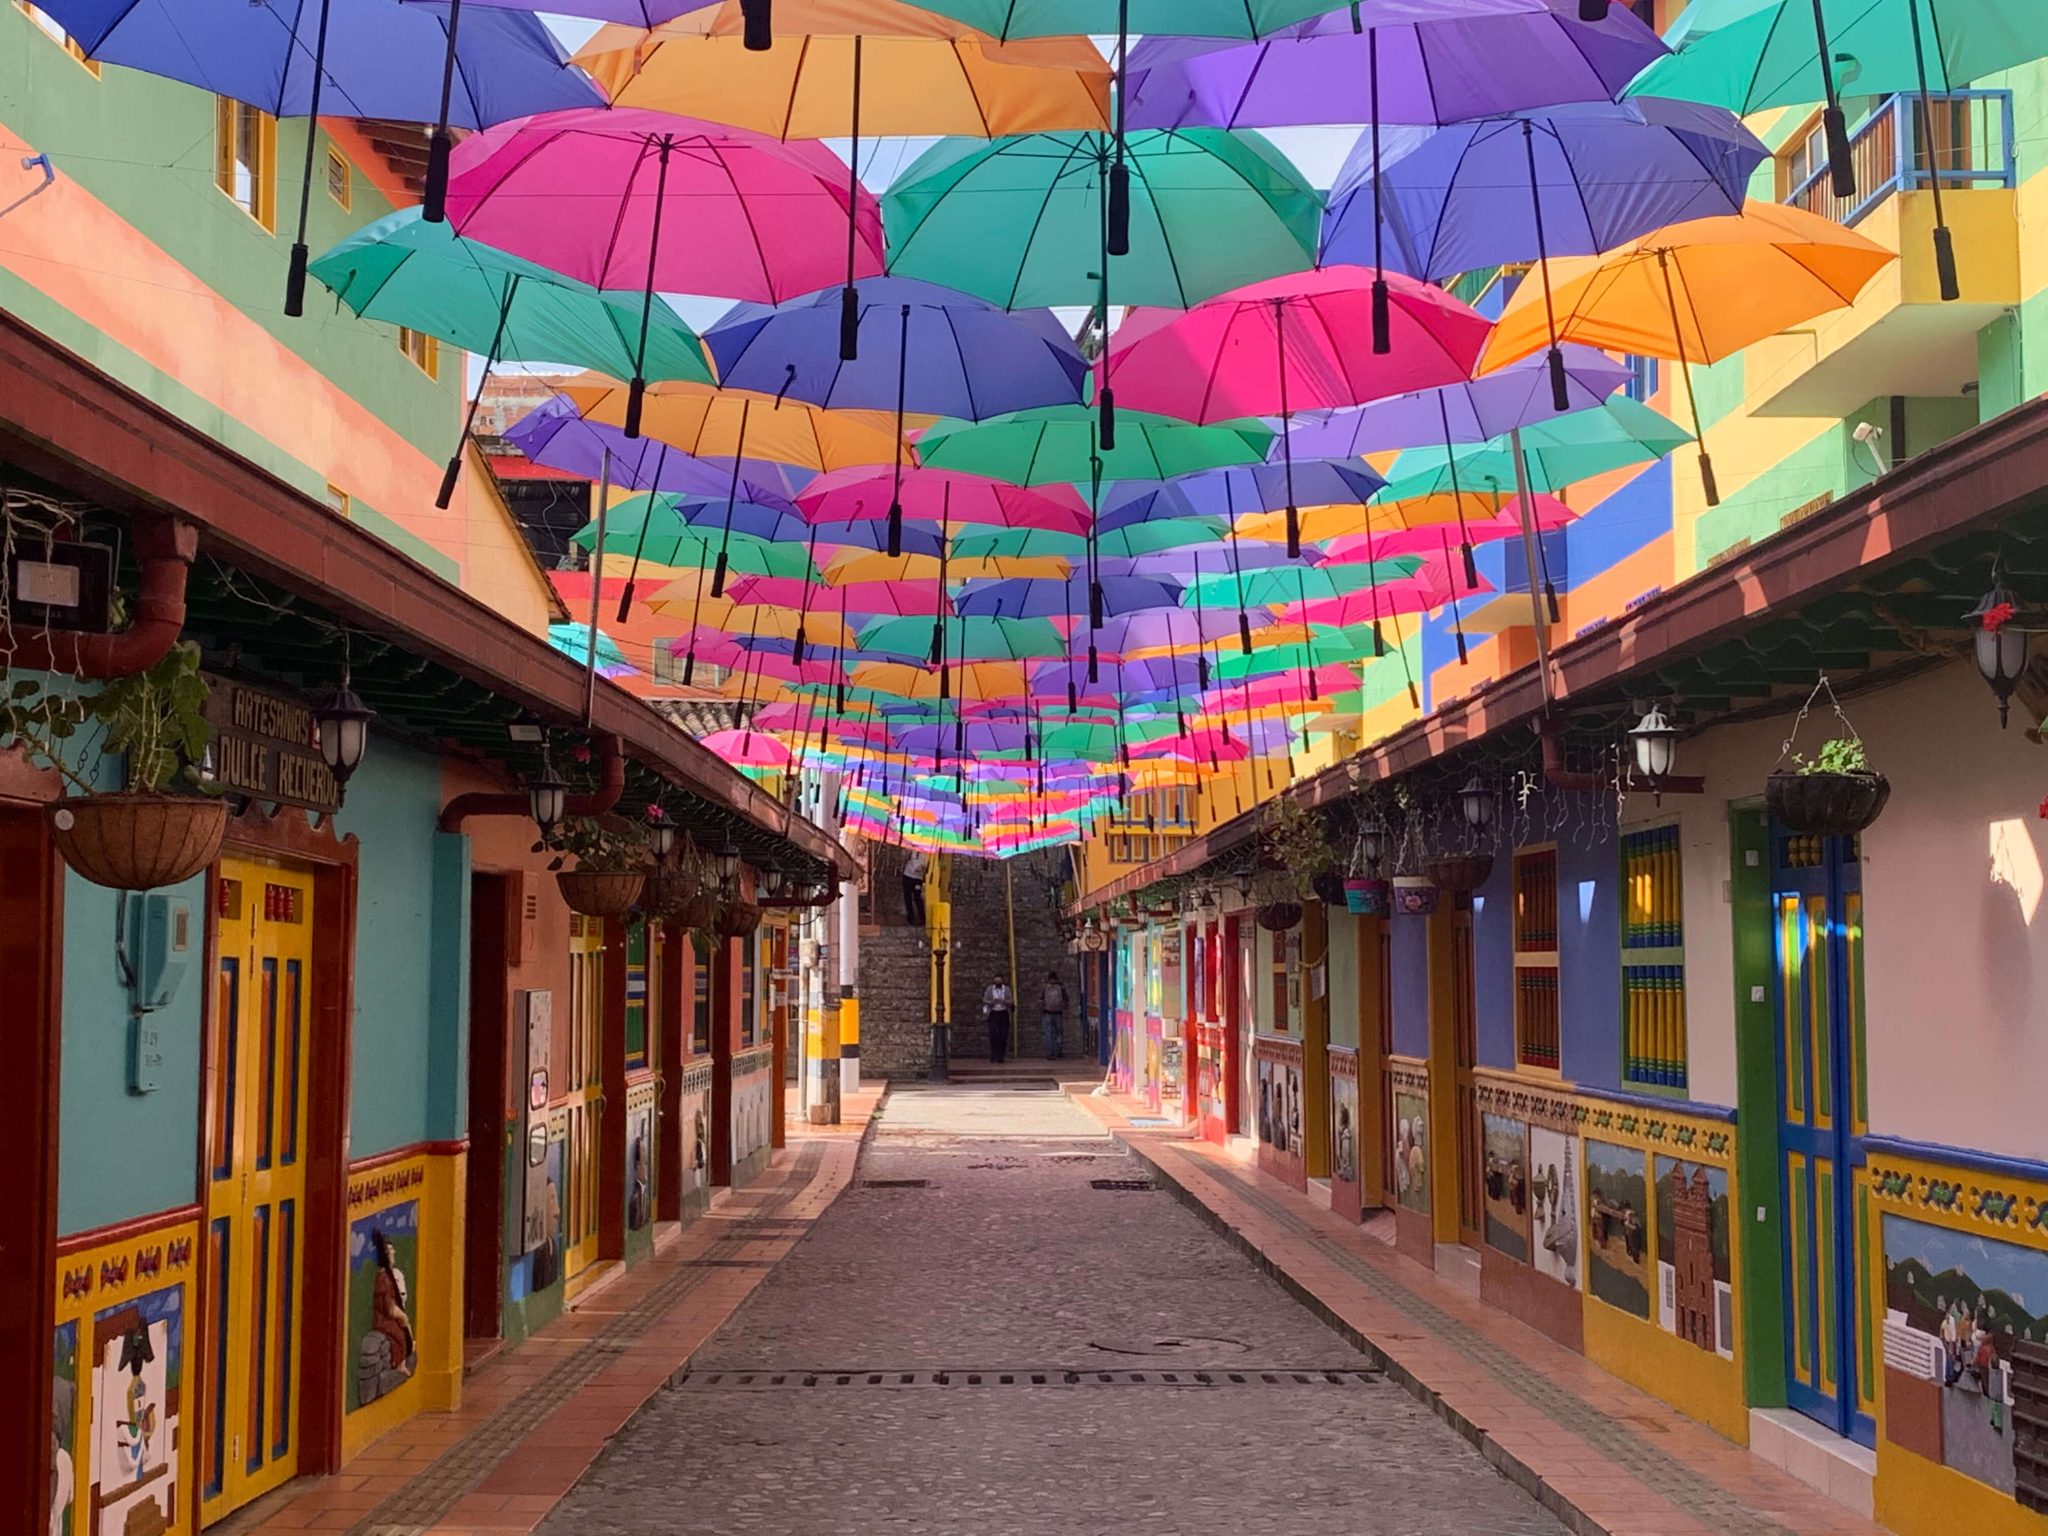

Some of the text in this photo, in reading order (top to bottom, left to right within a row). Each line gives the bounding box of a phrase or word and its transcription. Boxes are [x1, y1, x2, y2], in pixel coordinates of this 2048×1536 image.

[235, 690, 309, 745] ARTESANIAS
[220, 736, 338, 805] DULCE RECUERDO
